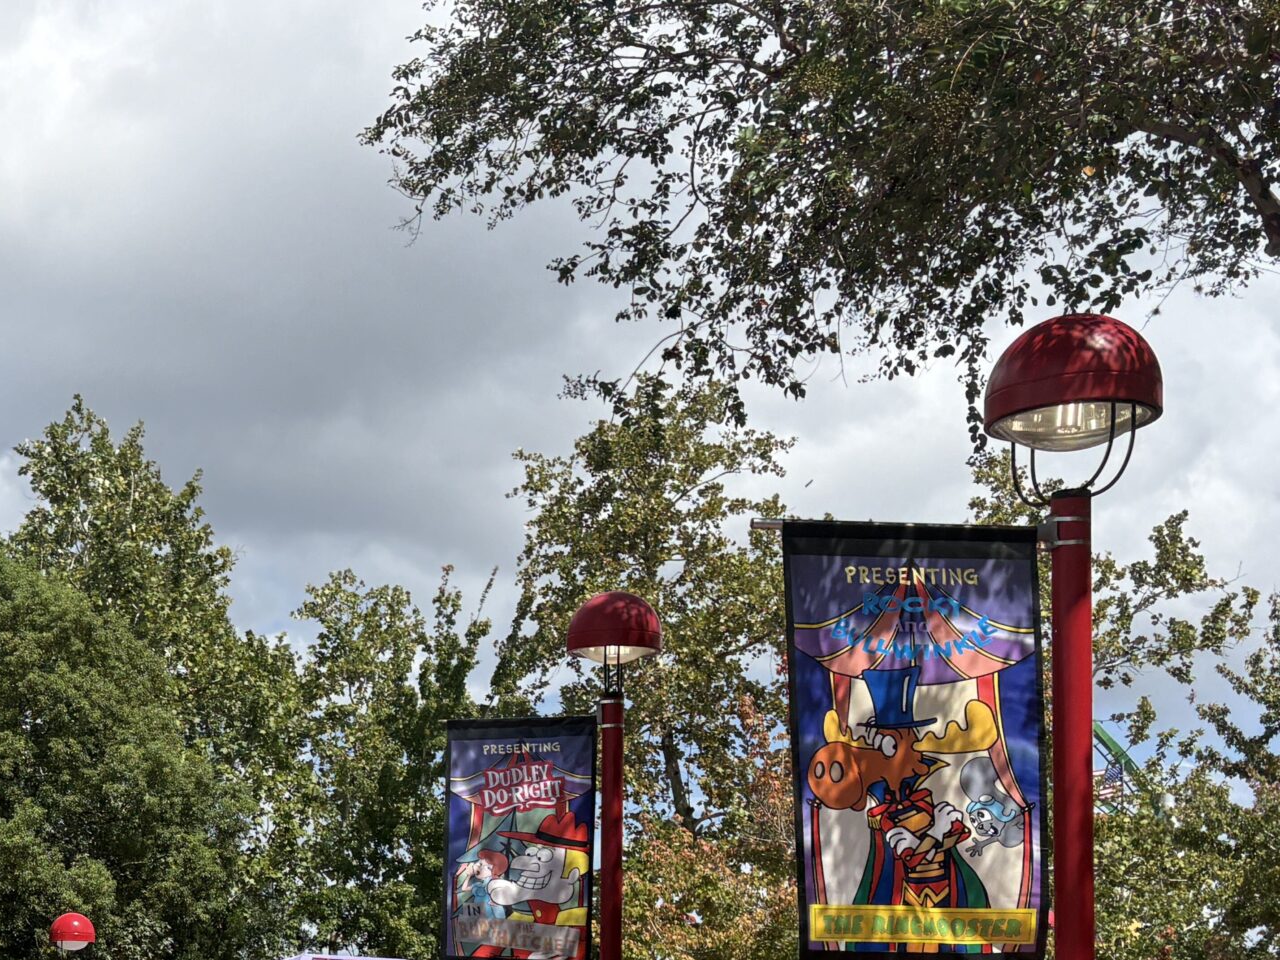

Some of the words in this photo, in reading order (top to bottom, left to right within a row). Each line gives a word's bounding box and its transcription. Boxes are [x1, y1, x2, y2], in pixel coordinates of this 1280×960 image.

[845, 566, 979, 586] PRESENTING
[862, 592, 962, 619] ROCKY
[832, 615, 998, 661] BULLWINKLE
[482, 742, 561, 756] PRESENTING
[486, 764, 549, 788] DUDLEY
[467, 905, 481, 917] IN
[822, 915, 864, 935] THE
